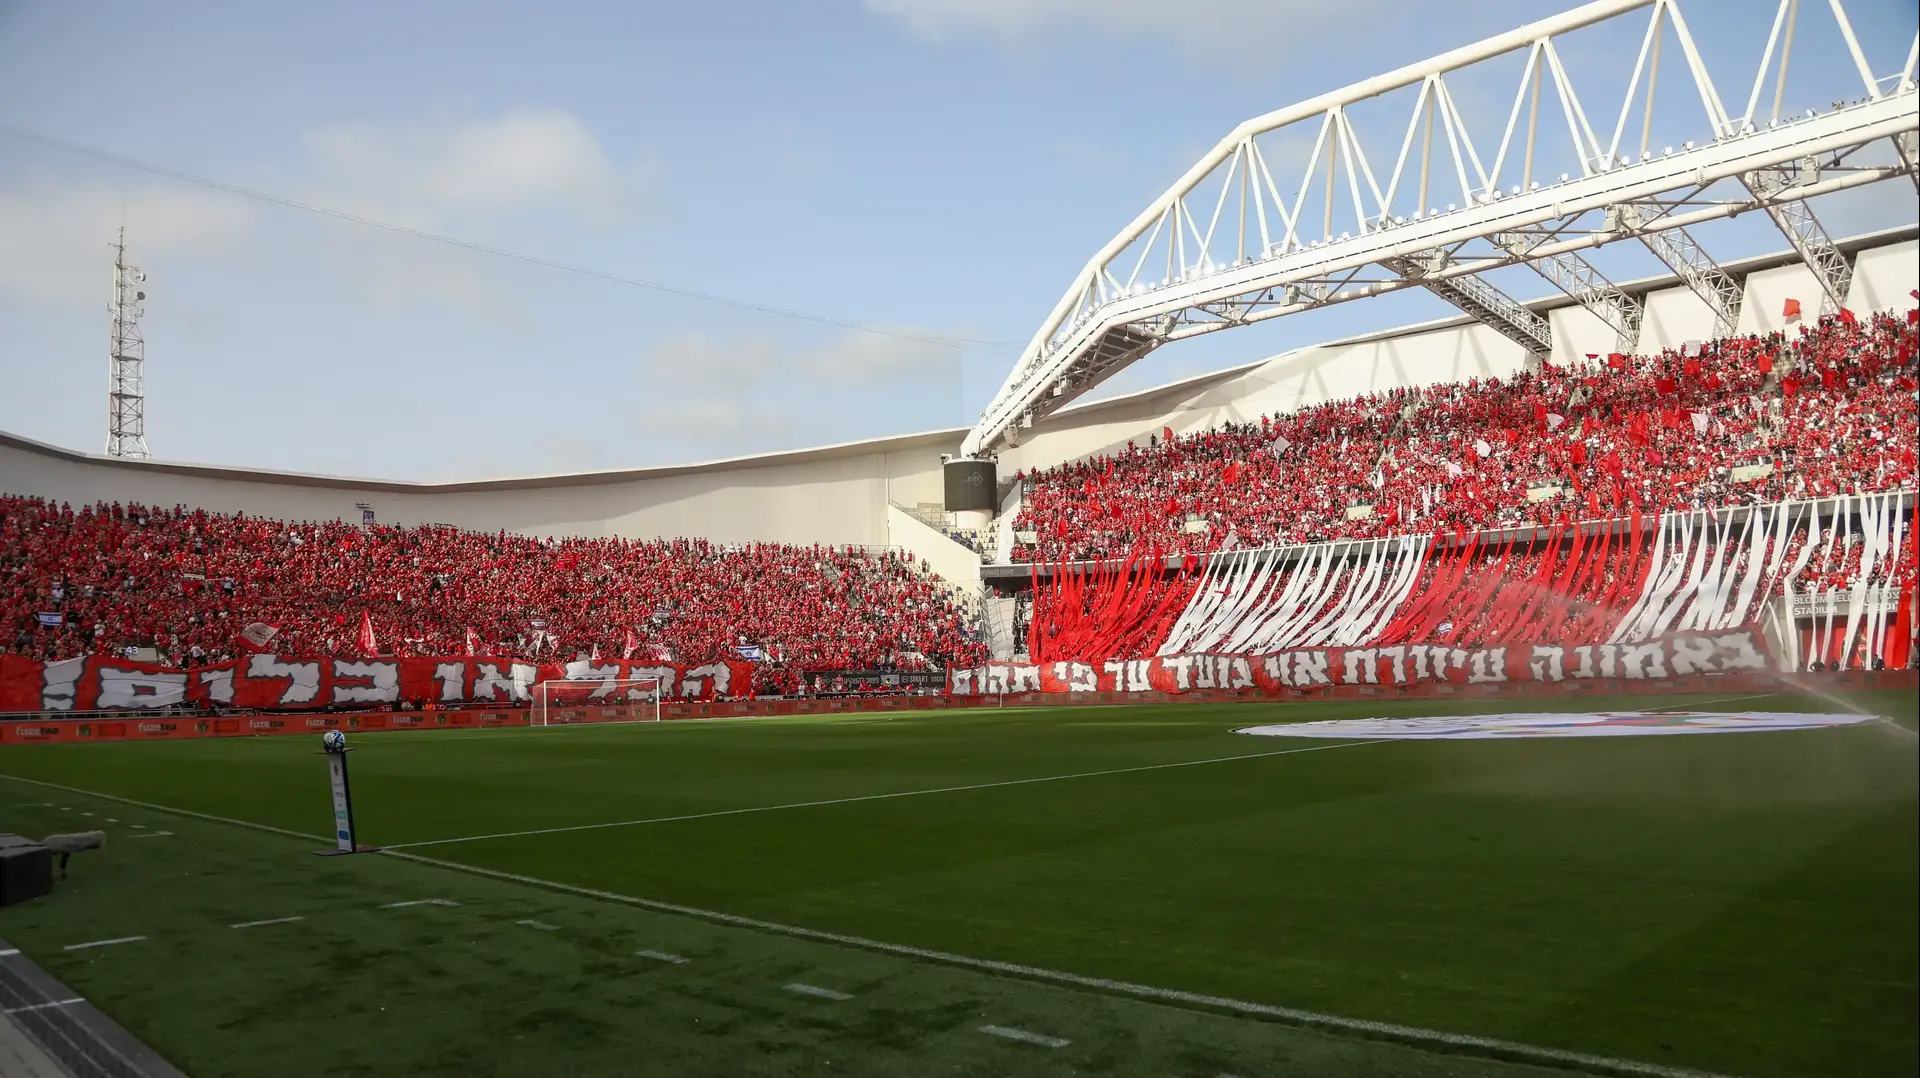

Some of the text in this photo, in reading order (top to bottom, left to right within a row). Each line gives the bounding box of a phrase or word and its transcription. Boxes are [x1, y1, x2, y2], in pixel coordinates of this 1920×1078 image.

[1529, 632, 1764, 682] באמונה
[434, 661, 537, 703] או
[909, 675, 928, 684] SMART
[249, 719, 284, 728] fuzetea
[305, 717, 338, 726] fuzetea
[393, 715, 424, 723] fuzetea
[16, 726, 58, 736] fuzetea
[138, 722, 177, 732] fuzetea
